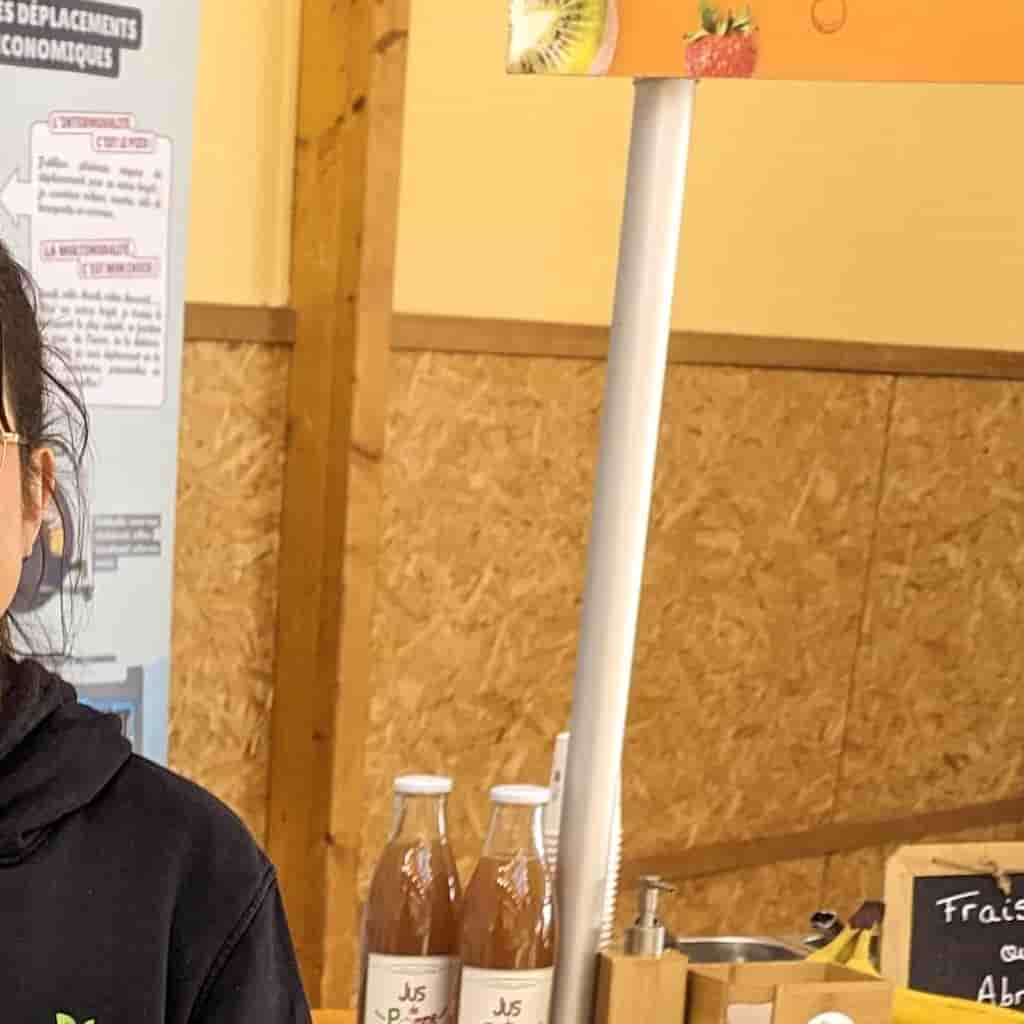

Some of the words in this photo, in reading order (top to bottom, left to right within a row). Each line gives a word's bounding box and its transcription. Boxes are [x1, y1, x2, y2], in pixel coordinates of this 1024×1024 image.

[17, 4, 137, 41] DÉPLACEMENTS
[398, 981, 427, 1002] Jus
[492, 996, 523, 1018] Jus
